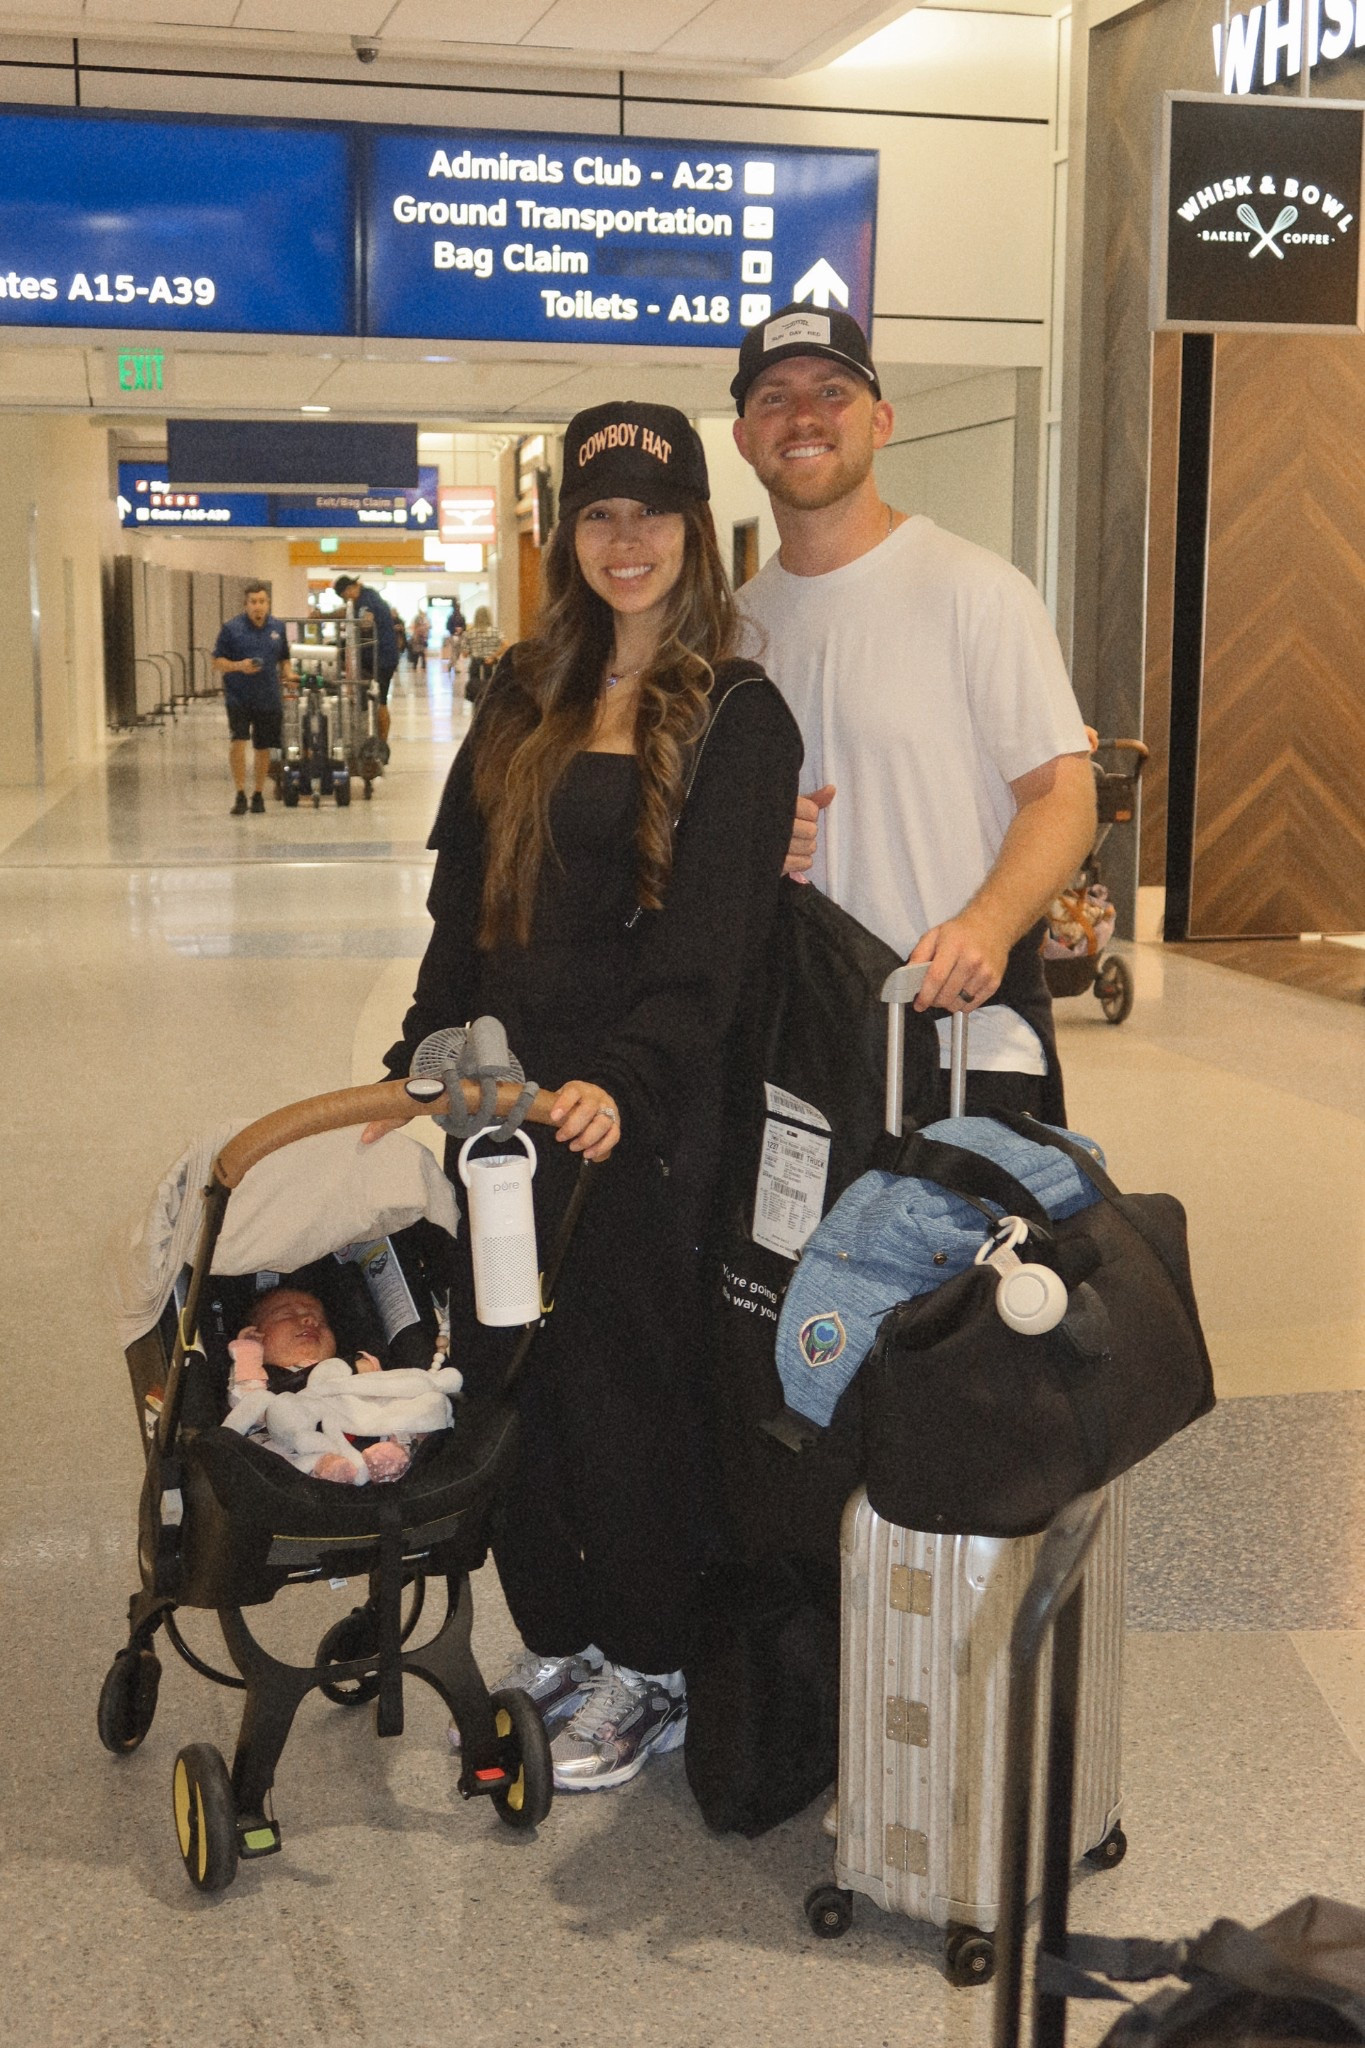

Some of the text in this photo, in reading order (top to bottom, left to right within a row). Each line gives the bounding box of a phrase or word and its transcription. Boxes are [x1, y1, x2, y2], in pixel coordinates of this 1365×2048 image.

[1212, 0, 1365, 96] WHIS
[428, 150, 564, 184] Admirals
[573, 156, 642, 187] Club
[672, 162, 734, 192] A23
[393, 195, 733, 238] Ground Transportation
[1177, 175, 1354, 233] WHISK & BOWL
[1202, 231, 1330, 244] BAKERY COFFEE
[434, 241, 589, 278] Bag Claim
[68, 273, 216, 306] A15-A39
[540, 289, 638, 321] Toilets
[668, 294, 730, 324] A18
[117, 354, 165, 391] EXIT
[578, 422, 672, 467] COWBOY HAT
[362, 496, 391, 508] Claim
[733, 1296, 777, 1320] way you
[749, 1282, 778, 1303] going
